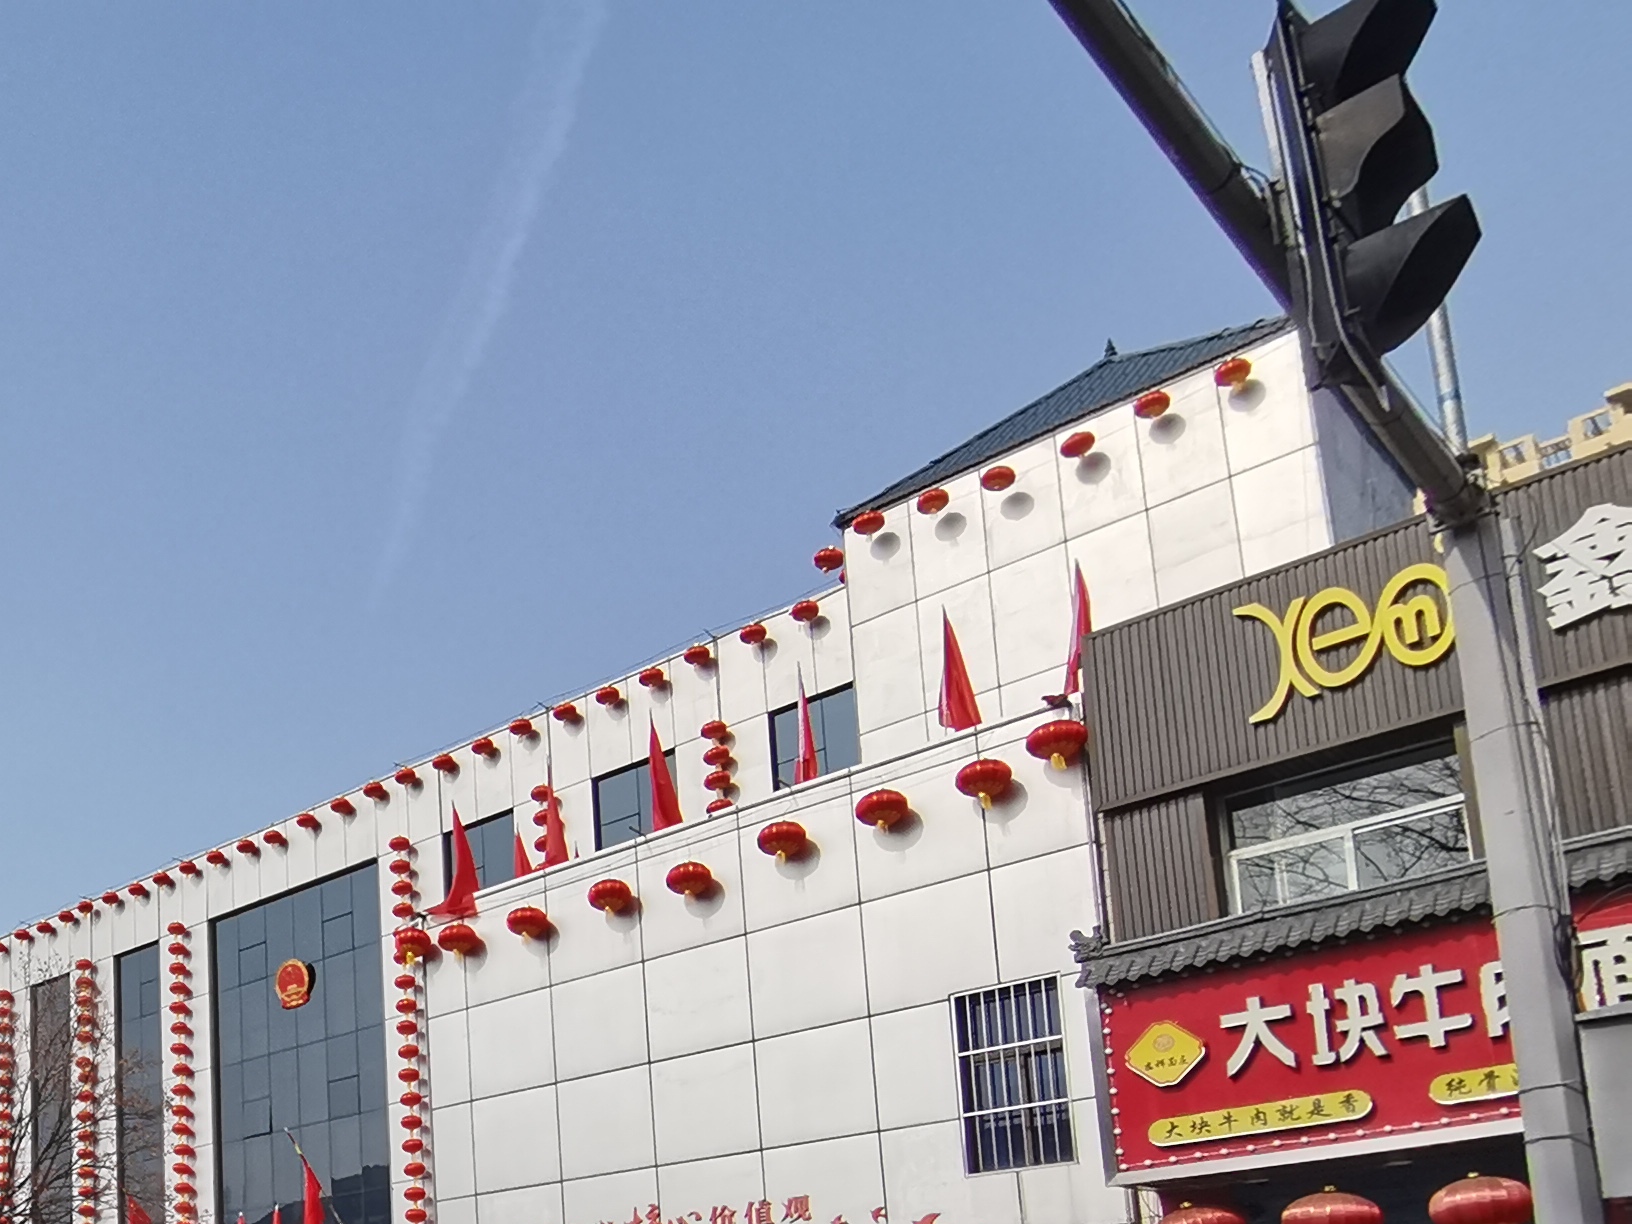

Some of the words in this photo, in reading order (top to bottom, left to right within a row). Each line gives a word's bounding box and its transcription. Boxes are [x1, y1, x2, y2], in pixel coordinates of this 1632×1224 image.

[1445, 1067, 1519, 1098] 纯骨
[1164, 1091, 1360, 1139] 大块牛肉就是香
